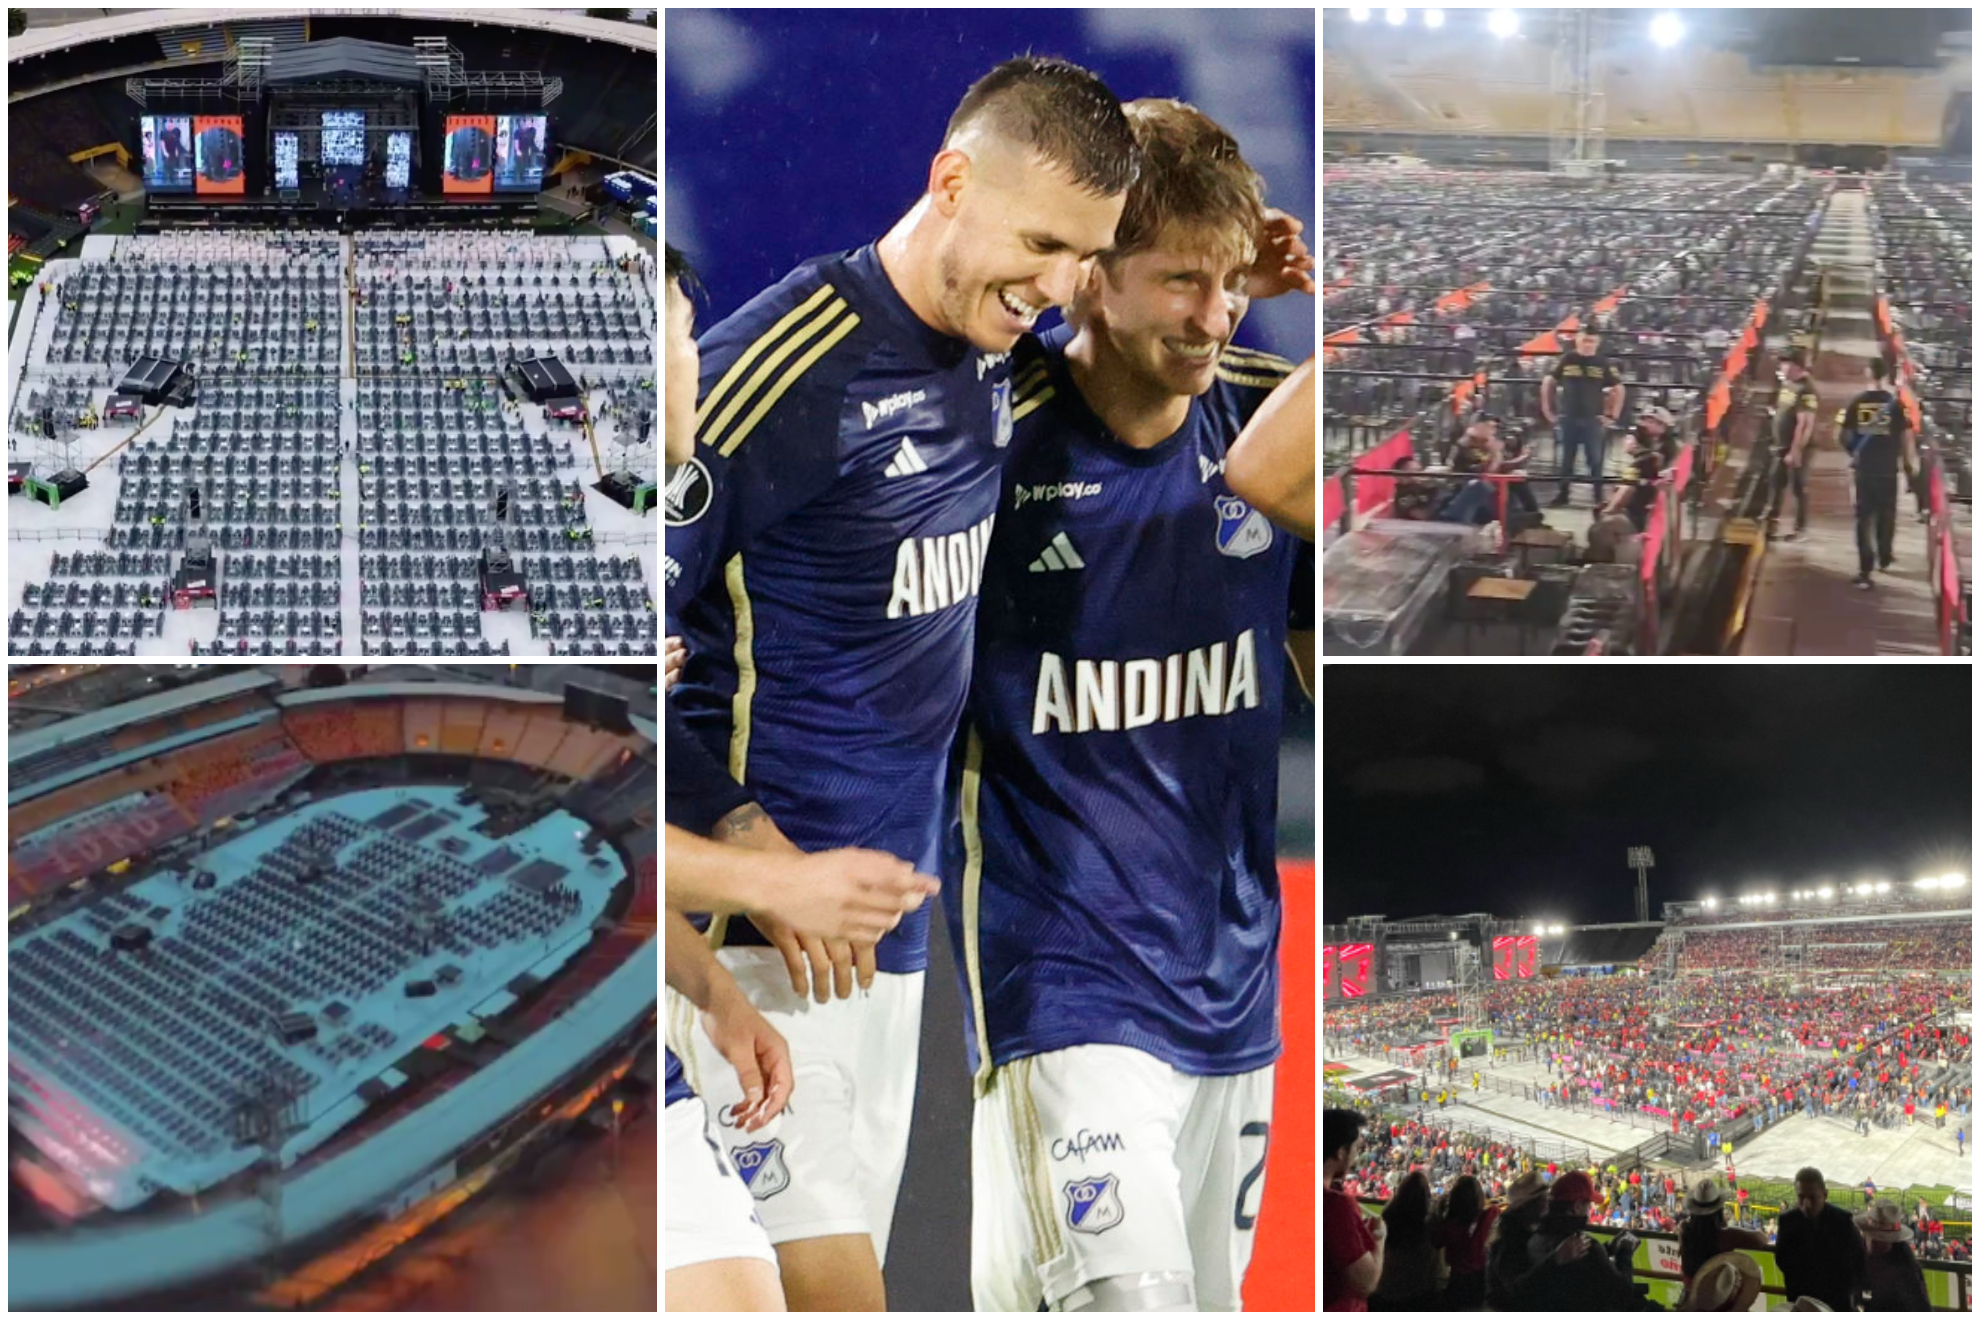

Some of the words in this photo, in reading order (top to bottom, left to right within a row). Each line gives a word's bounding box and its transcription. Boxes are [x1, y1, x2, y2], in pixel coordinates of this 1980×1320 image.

[1033, 481, 1104, 502] wplay.co
[1032, 629, 1260, 735] ANDINA
[1234, 1121, 1269, 1230] 2
